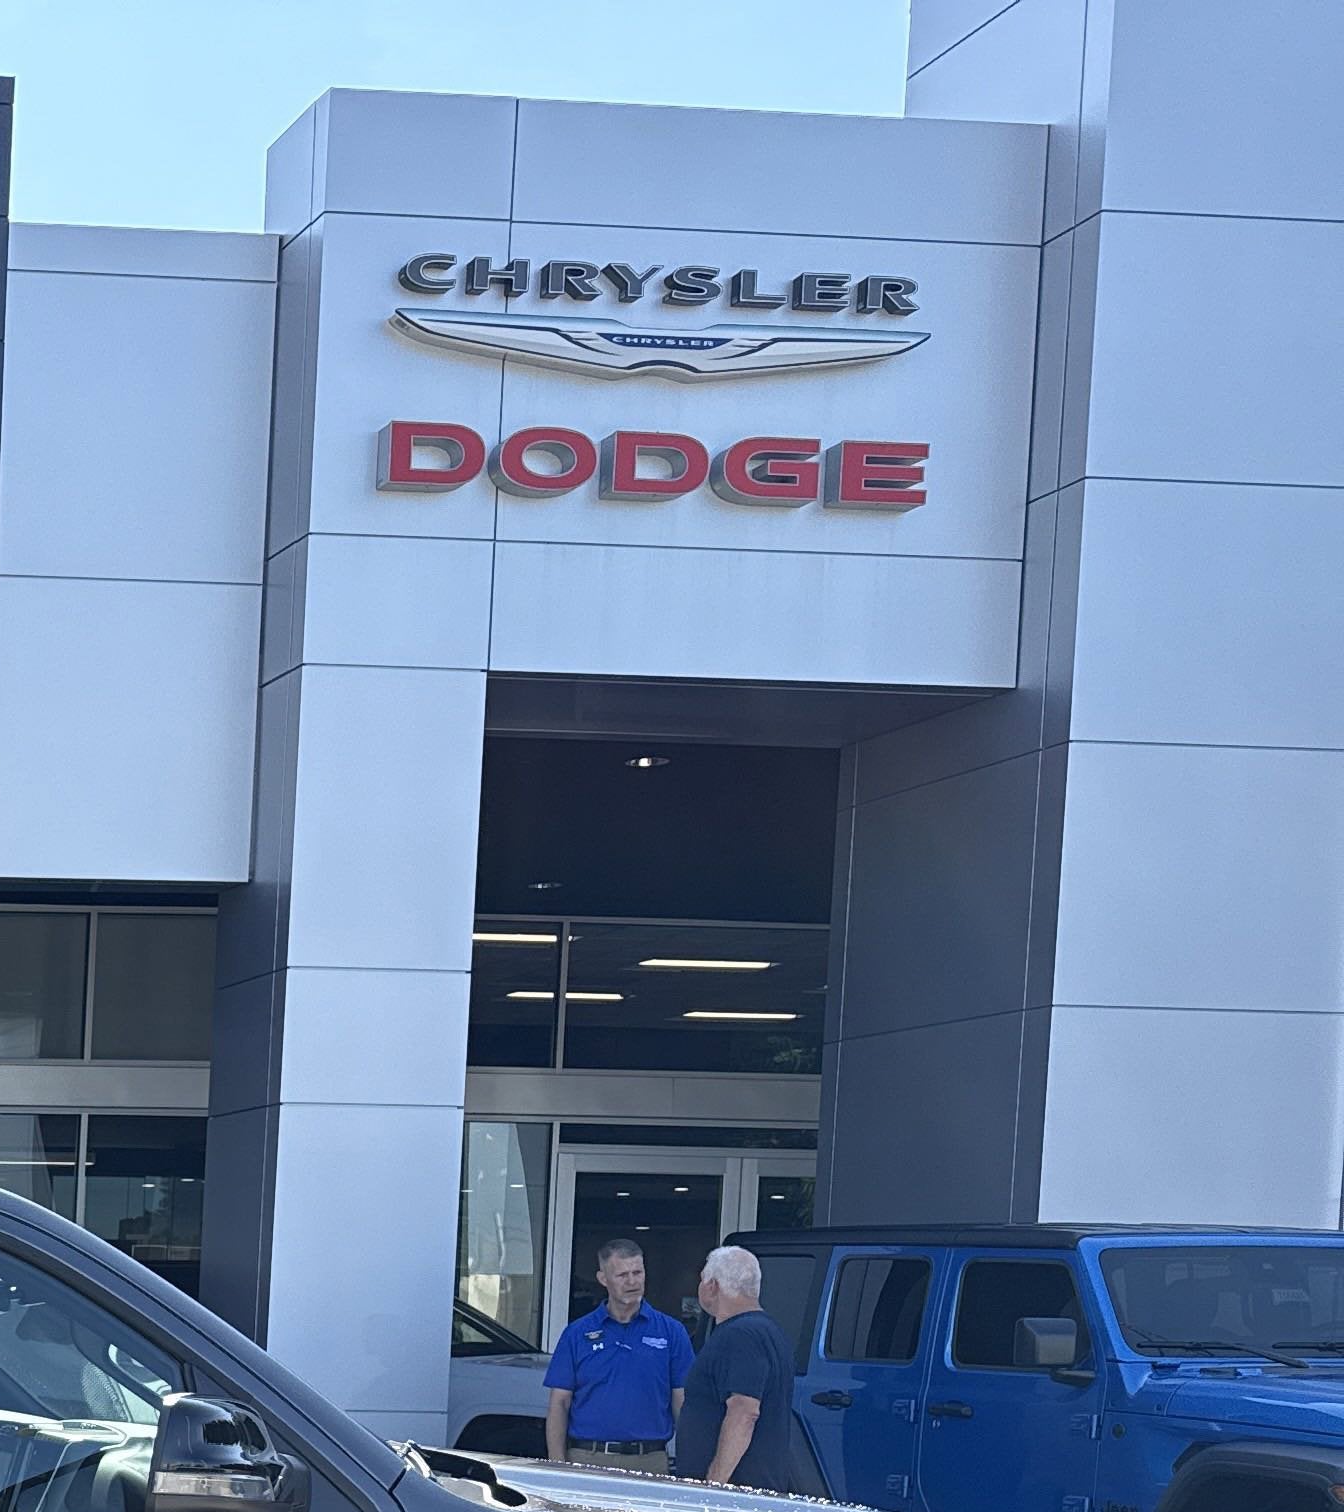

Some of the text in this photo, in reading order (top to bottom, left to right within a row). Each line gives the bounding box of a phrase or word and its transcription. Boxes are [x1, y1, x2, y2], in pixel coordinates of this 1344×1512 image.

[398, 252, 920, 317] CHRYSLER
[611, 335, 715, 347] CHRYSLER
[376, 420, 931, 512] DODGE
